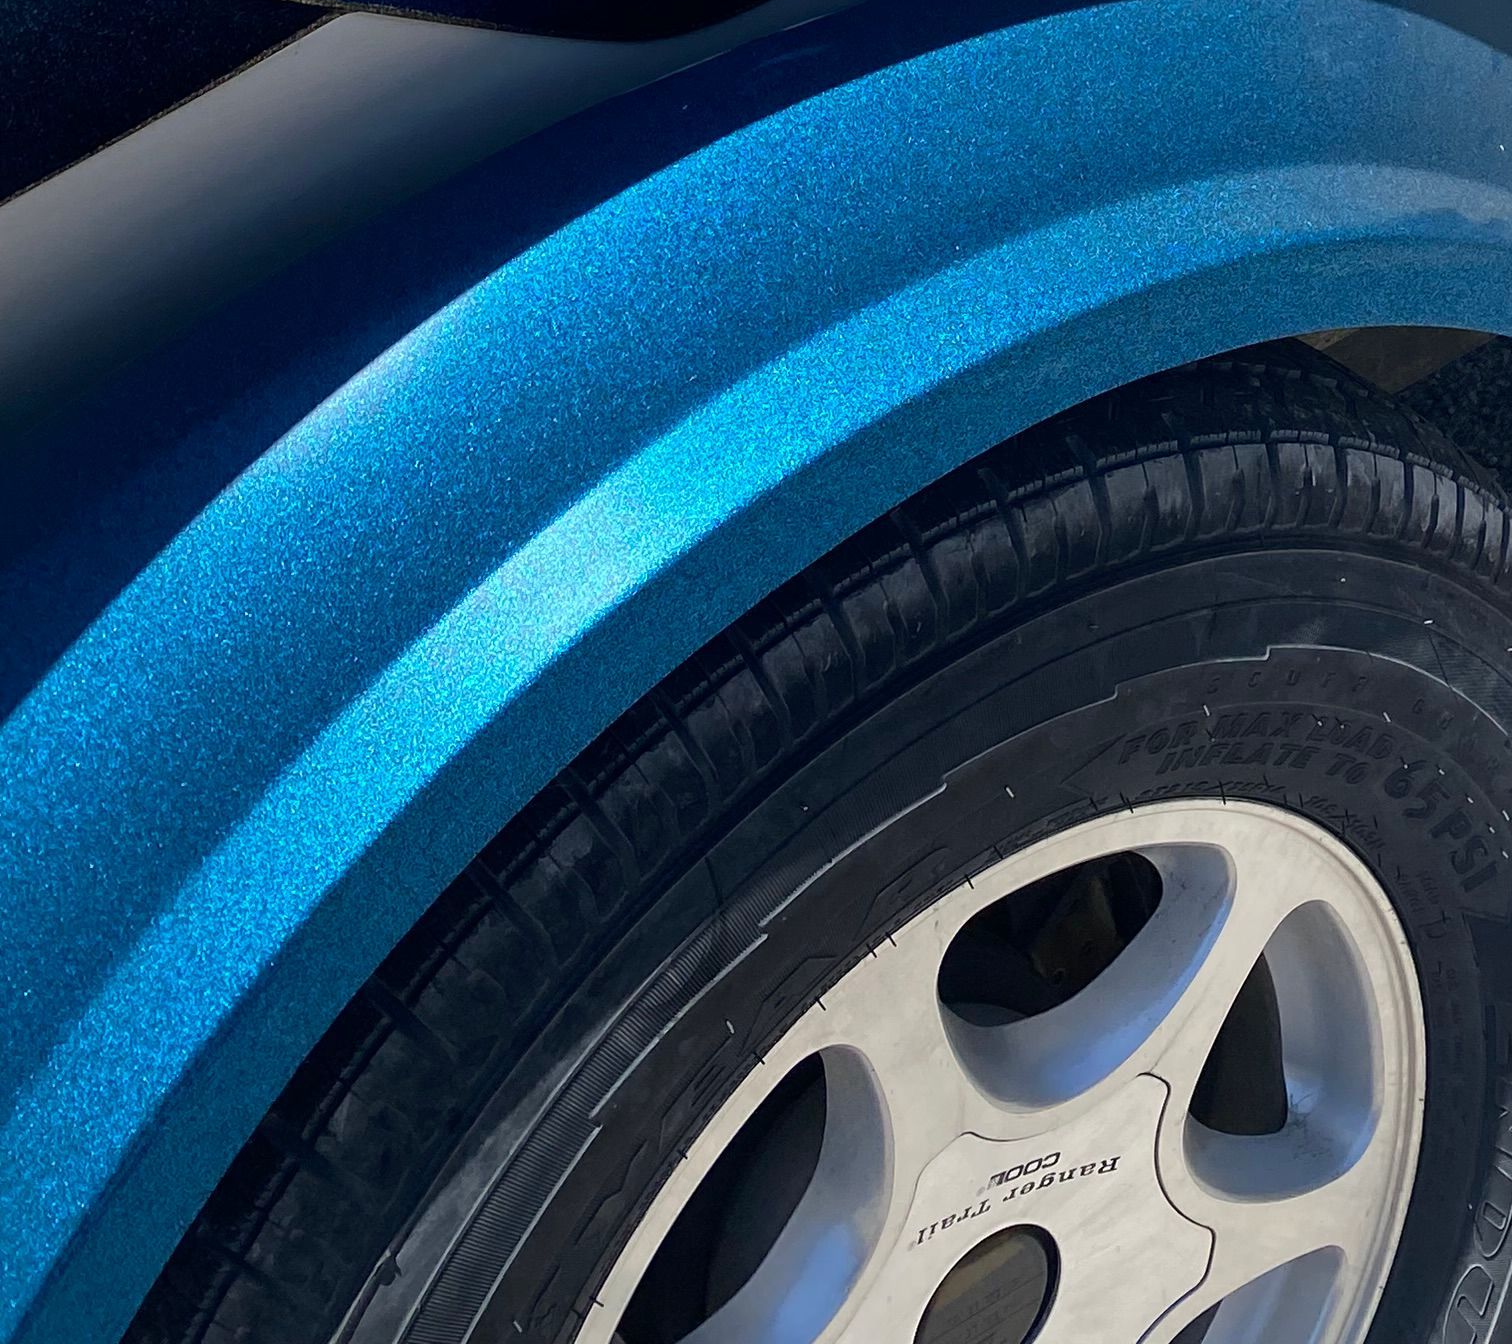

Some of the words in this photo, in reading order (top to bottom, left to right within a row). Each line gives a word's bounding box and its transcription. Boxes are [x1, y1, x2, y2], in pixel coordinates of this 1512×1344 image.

[1117, 718, 1200, 766] FOR
[1211, 711, 1303, 740] MAX
[1307, 717, 1395, 761] LOAD
[1155, 742, 1320, 777] INFLATE
[1325, 753, 1372, 785] TO
[1002, 1156, 1121, 1202] Ranger
[916, 1198, 991, 1245] Trail
